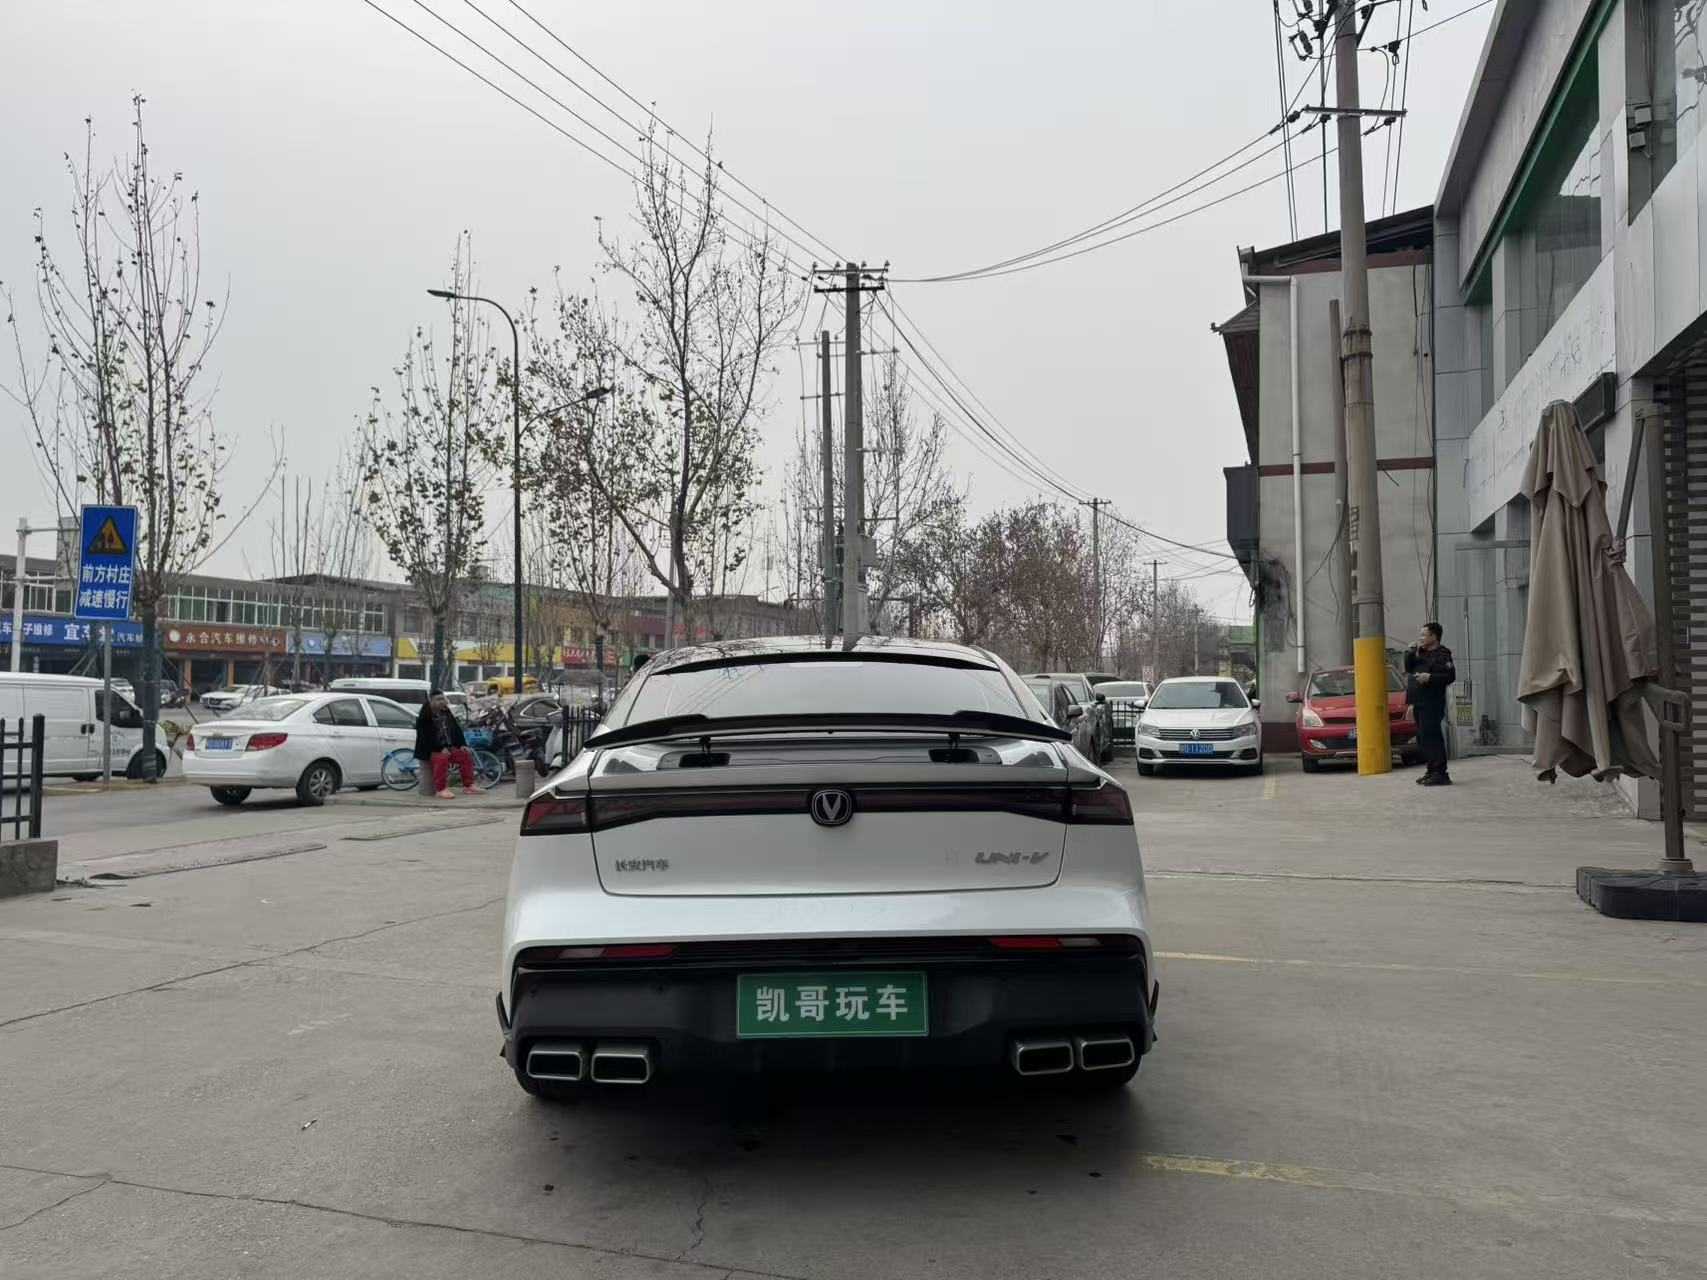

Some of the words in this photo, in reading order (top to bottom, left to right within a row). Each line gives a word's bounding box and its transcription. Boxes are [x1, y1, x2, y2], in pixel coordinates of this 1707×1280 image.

[82, 564, 131, 584] 前方村庄
[79, 588, 128, 608] 减速慢行
[615, 858, 669, 873] 长安汽车
[975, 851, 1049, 864] UNI-V
[755, 984, 909, 1022] 凯哥玩车
